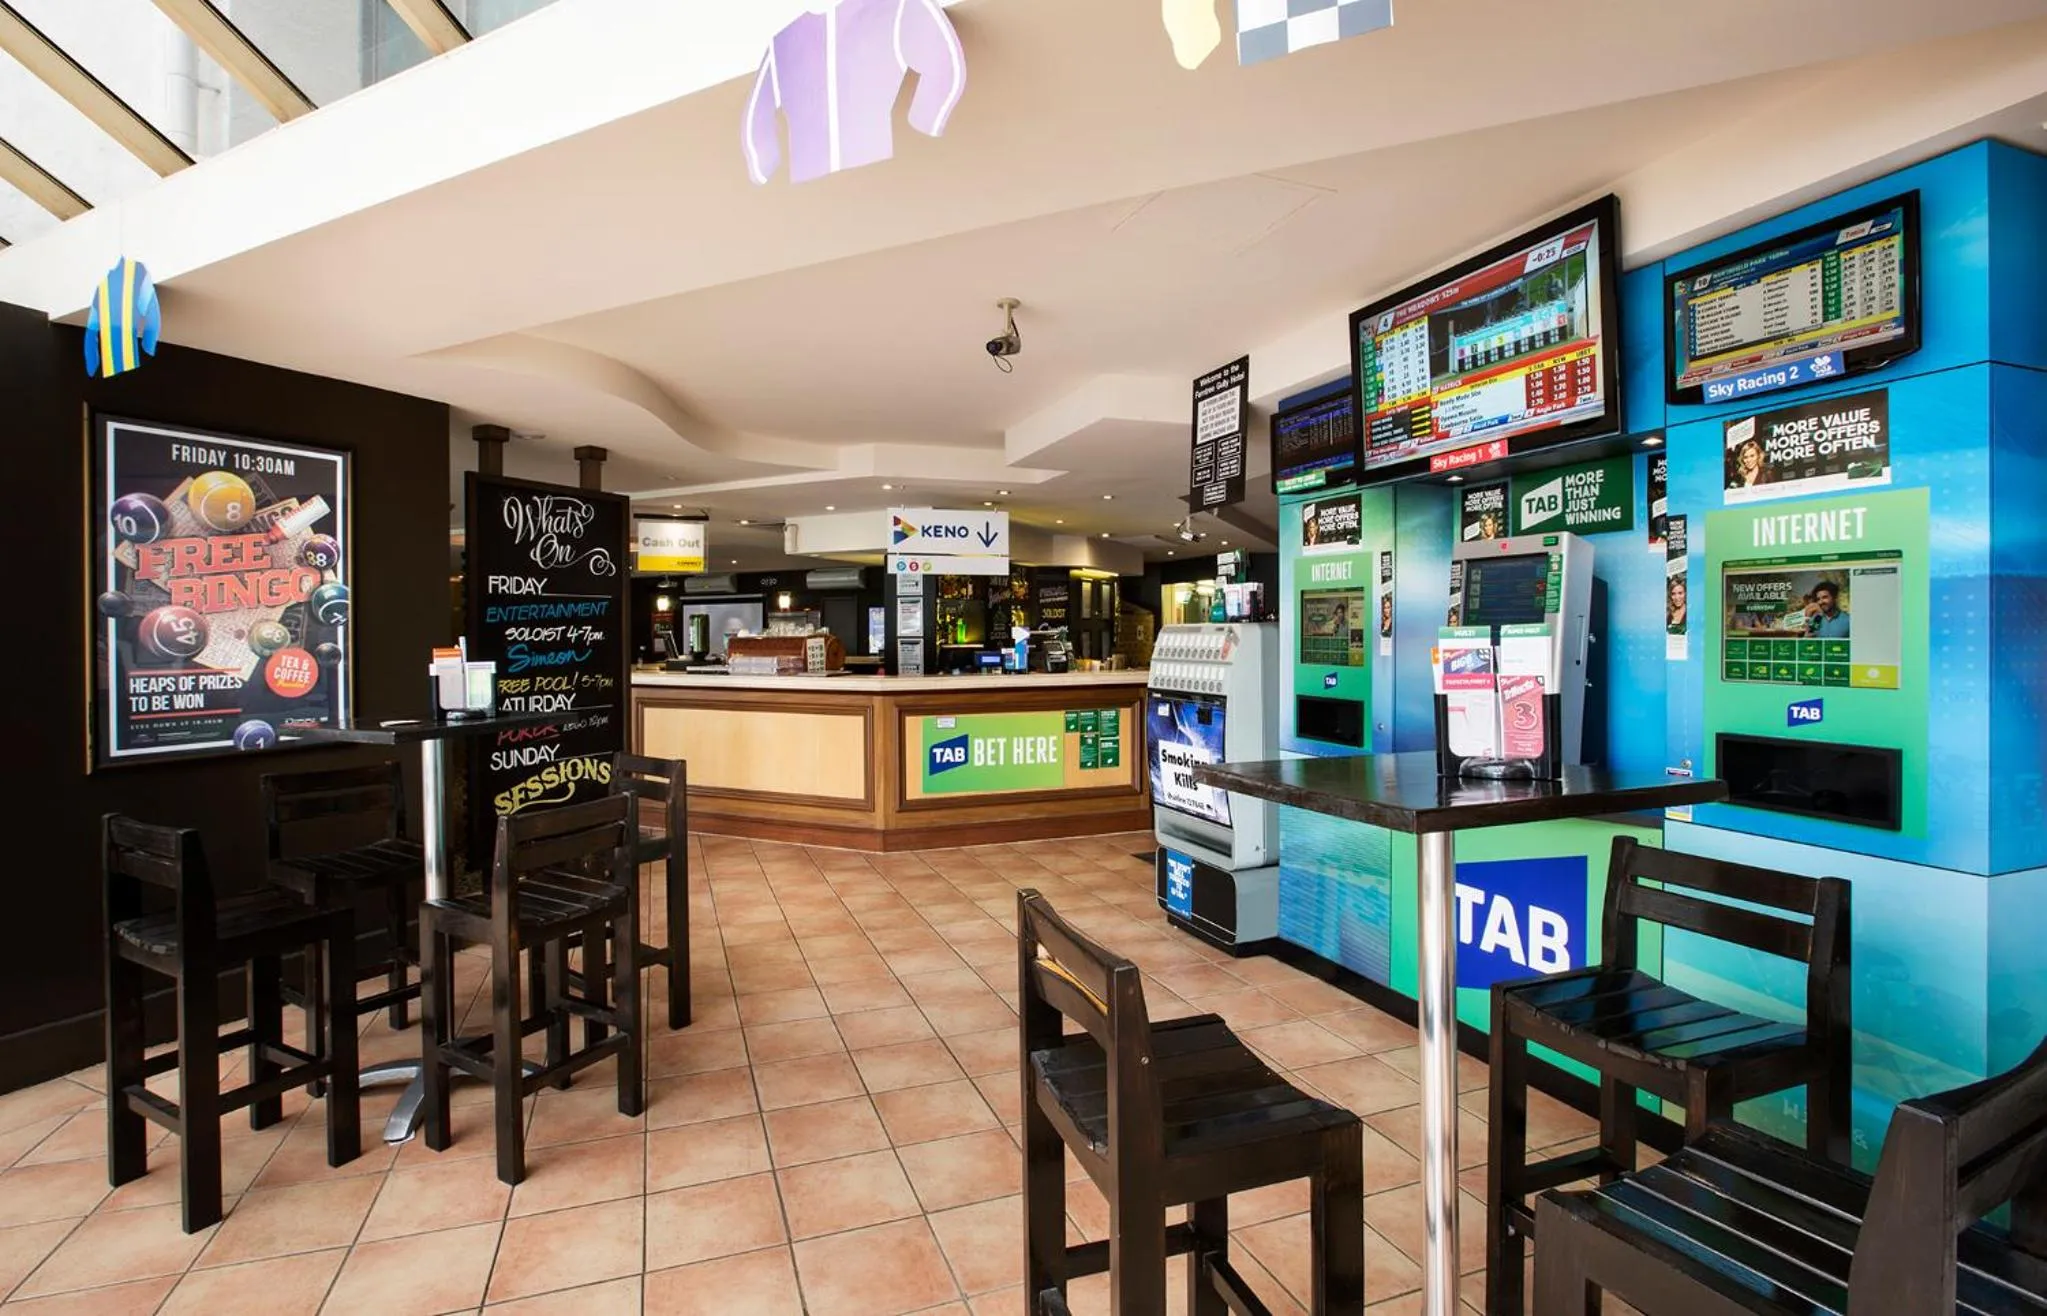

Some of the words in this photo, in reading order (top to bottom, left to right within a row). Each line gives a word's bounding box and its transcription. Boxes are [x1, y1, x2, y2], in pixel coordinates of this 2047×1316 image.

[1231, 364, 1239, 373] the
[1708, 382, 1734, 398] Sky
[1737, 368, 1788, 391] Racing
[1789, 366, 1799, 380] 2
[1772, 417, 1818, 437] MORE
[1822, 408, 1870, 426] VALUE
[1765, 432, 1810, 451] MORE
[1813, 420, 1881, 442] OFFERS
[1769, 445, 1815, 463] MORE
[1819, 434, 1876, 455] OFTEN
[171, 443, 228, 467] FRIDAY
[234, 452, 295, 476] 10:30AM
[1432, 456, 1447, 470] Sky
[1449, 448, 1476, 465] Racing
[1565, 469, 1604, 486] MORE
[1565, 484, 1599, 498] THAN
[226, 502, 241, 521] 8
[1320, 508, 1337, 516] MORE
[1526, 495, 1557, 514] TAB
[1565, 498, 1595, 510] JUST
[113, 513, 137, 536] 10
[1564, 506, 1621, 525] WINNING
[921, 525, 969, 538] KENO
[1753, 508, 1867, 547] INTERNET
[642, 537, 674, 548] Cash
[678, 537, 700, 548] Out
[135, 533, 272, 579] FREE
[1312, 561, 1352, 582] INTERNET
[168, 566, 321, 614] BINGO
[488, 575, 548, 595] FRIDAY
[1732, 583, 1756, 593] NEW
[1757, 582, 1792, 592] OFFERS
[1738, 591, 1788, 600] AVAILABLE
[486, 601, 609, 624] ENTERTAINMENT
[175, 617, 196, 645] 45
[505, 626, 566, 642] SOLOIST
[280, 655, 299, 668] TEA
[302, 658, 309, 670] &
[507, 643, 592, 673] Simeon
[130, 677, 175, 694] HEAPS
[179, 675, 196, 691] OF
[199, 674, 242, 690] PRIZES
[273, 666, 311, 682] COFFEE
[498, 677, 530, 694] FREE
[534, 672, 580, 692] POOL!
[130, 696, 148, 712] TO
[152, 695, 169, 711] BE
[173, 693, 205, 710] WON
[499, 692, 576, 712] ATURDAY
[1512, 702, 1538, 730] 3
[1790, 706, 1821, 720] TAB
[256, 738, 264, 749] 1
[933, 748, 965, 763] TAB
[974, 737, 1007, 767] BET
[1013, 736, 1057, 765] HERE
[489, 744, 560, 771] SUNDAY
[494, 758, 612, 815] SESSIONS
[1174, 772, 1199, 791] Kills
[1455, 882, 1570, 974] TAB
